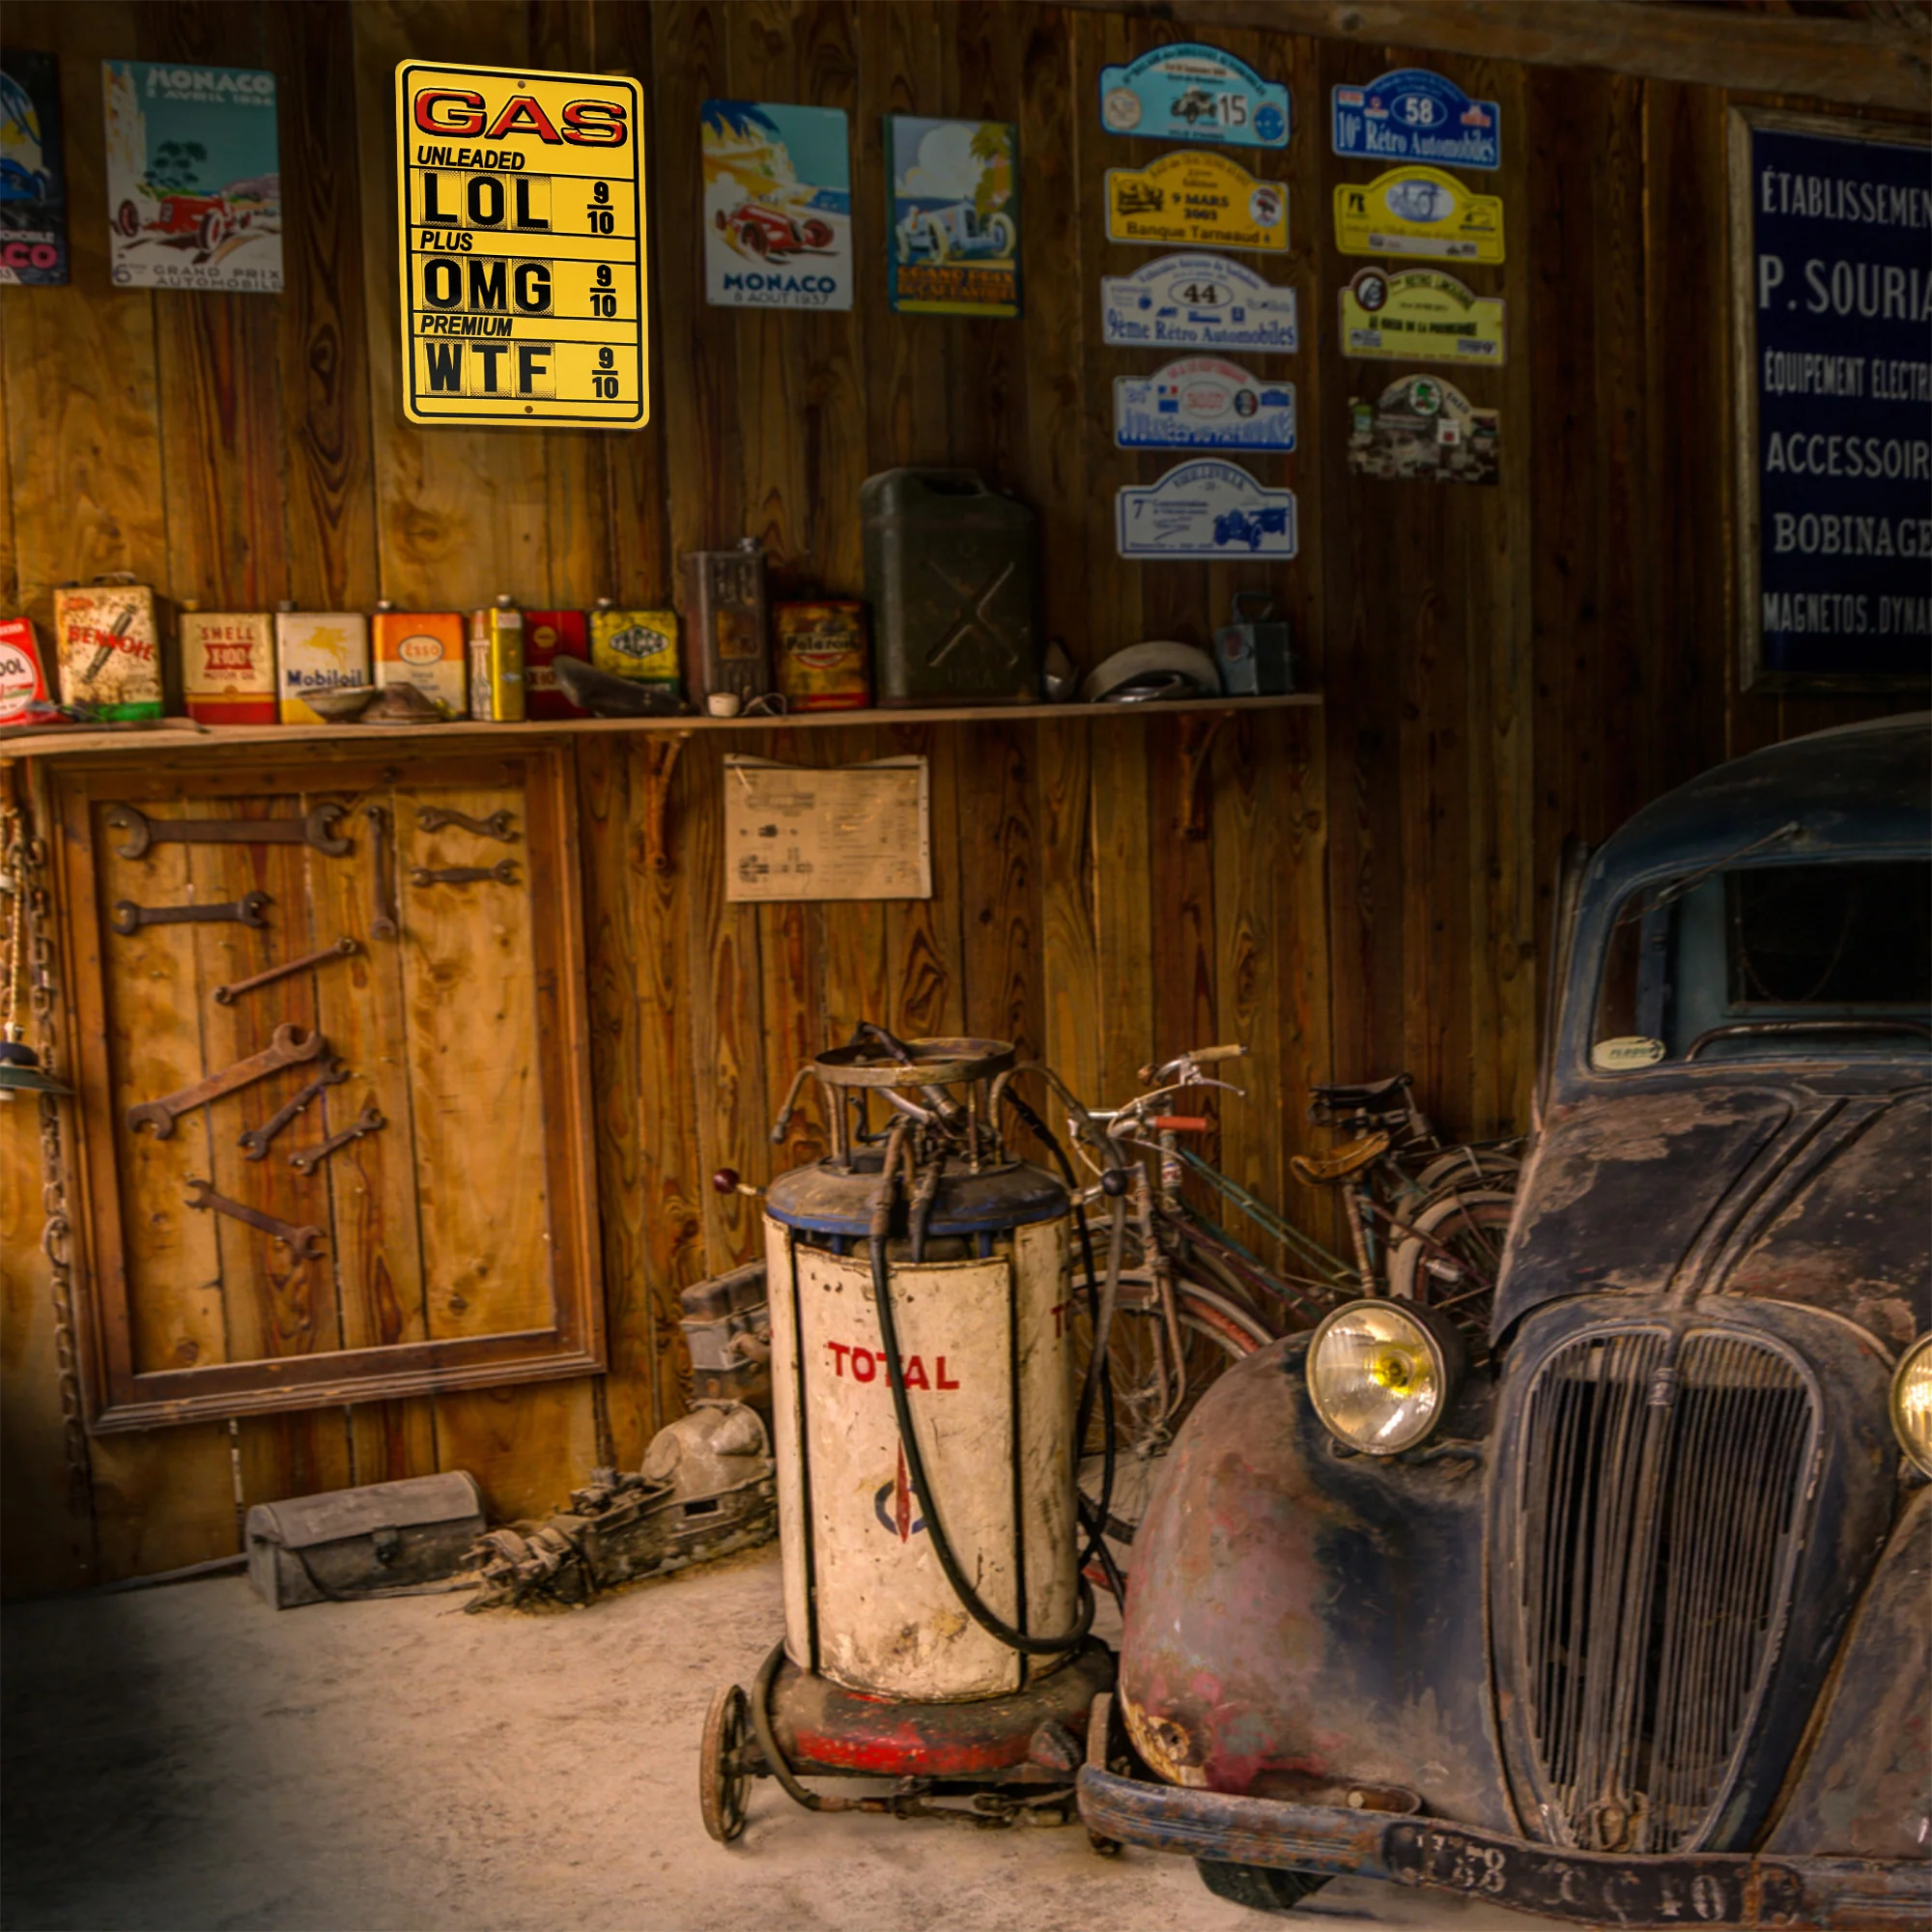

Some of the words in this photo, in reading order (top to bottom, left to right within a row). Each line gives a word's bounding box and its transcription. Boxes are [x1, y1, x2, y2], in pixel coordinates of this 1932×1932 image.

[146, 67, 274, 95] MONACO
[414, 88, 628, 148] GAS
[1219, 95, 1247, 126] 15
[1405, 97, 1435, 125] 58
[1365, 120, 1407, 153] Rétro
[1410, 130, 1494, 162] Automobiles
[417, 146, 526, 170] UNLEADED
[424, 173, 549, 228] LOL
[1185, 194, 1230, 208] MARS
[420, 231, 473, 251] PLUS
[1126, 221, 1185, 241] Banque
[0, 241, 59, 269] CO
[153, 264, 221, 277] GRAND
[233, 268, 279, 279] PRIX
[156, 275, 283, 290] AUTOMOBILE
[723, 272, 837, 294] MONACO
[424, 258, 552, 312] OMG
[1183, 283, 1217, 304] 44
[420, 315, 513, 336] PREMIUM
[1155, 320, 1198, 341] Rétro
[1202, 320, 1294, 346] Automobiles
[425, 342, 552, 393] WTF
[201, 626, 255, 640] SHELL
[287, 668, 362, 687] Mobiloil
[828, 1341, 960, 1391] TOTAL
